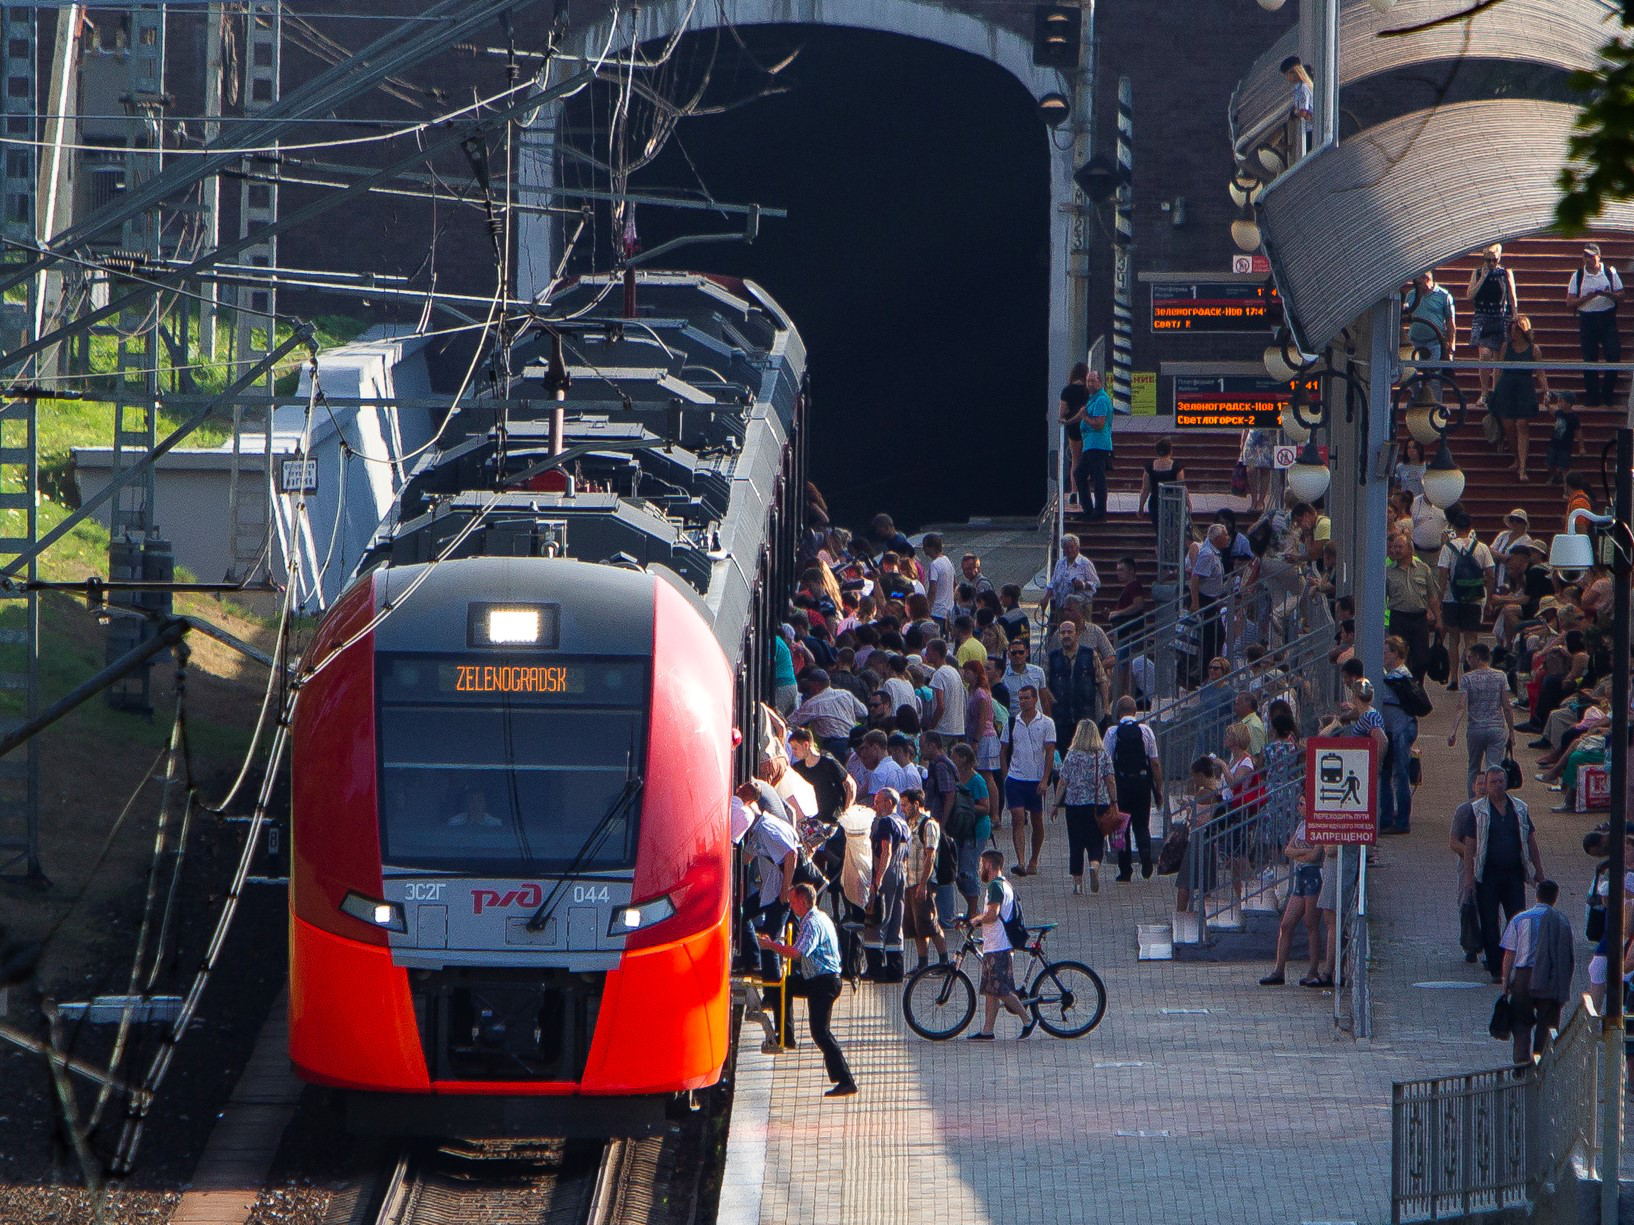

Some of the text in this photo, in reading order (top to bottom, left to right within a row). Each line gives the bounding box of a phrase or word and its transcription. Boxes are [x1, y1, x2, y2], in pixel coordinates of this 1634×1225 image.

[1190, 285, 1197, 299] 1
[1217, 378, 1225, 393] 1
[1177, 415, 1255, 425] Светлогорск-2
[456, 666, 567, 692] ZELENOGRADSK
[1310, 831, 1373, 843] ЗАПРЕЩЕНО!
[405, 883, 446, 901] ЭС2Г
[574, 886, 610, 904] 044
